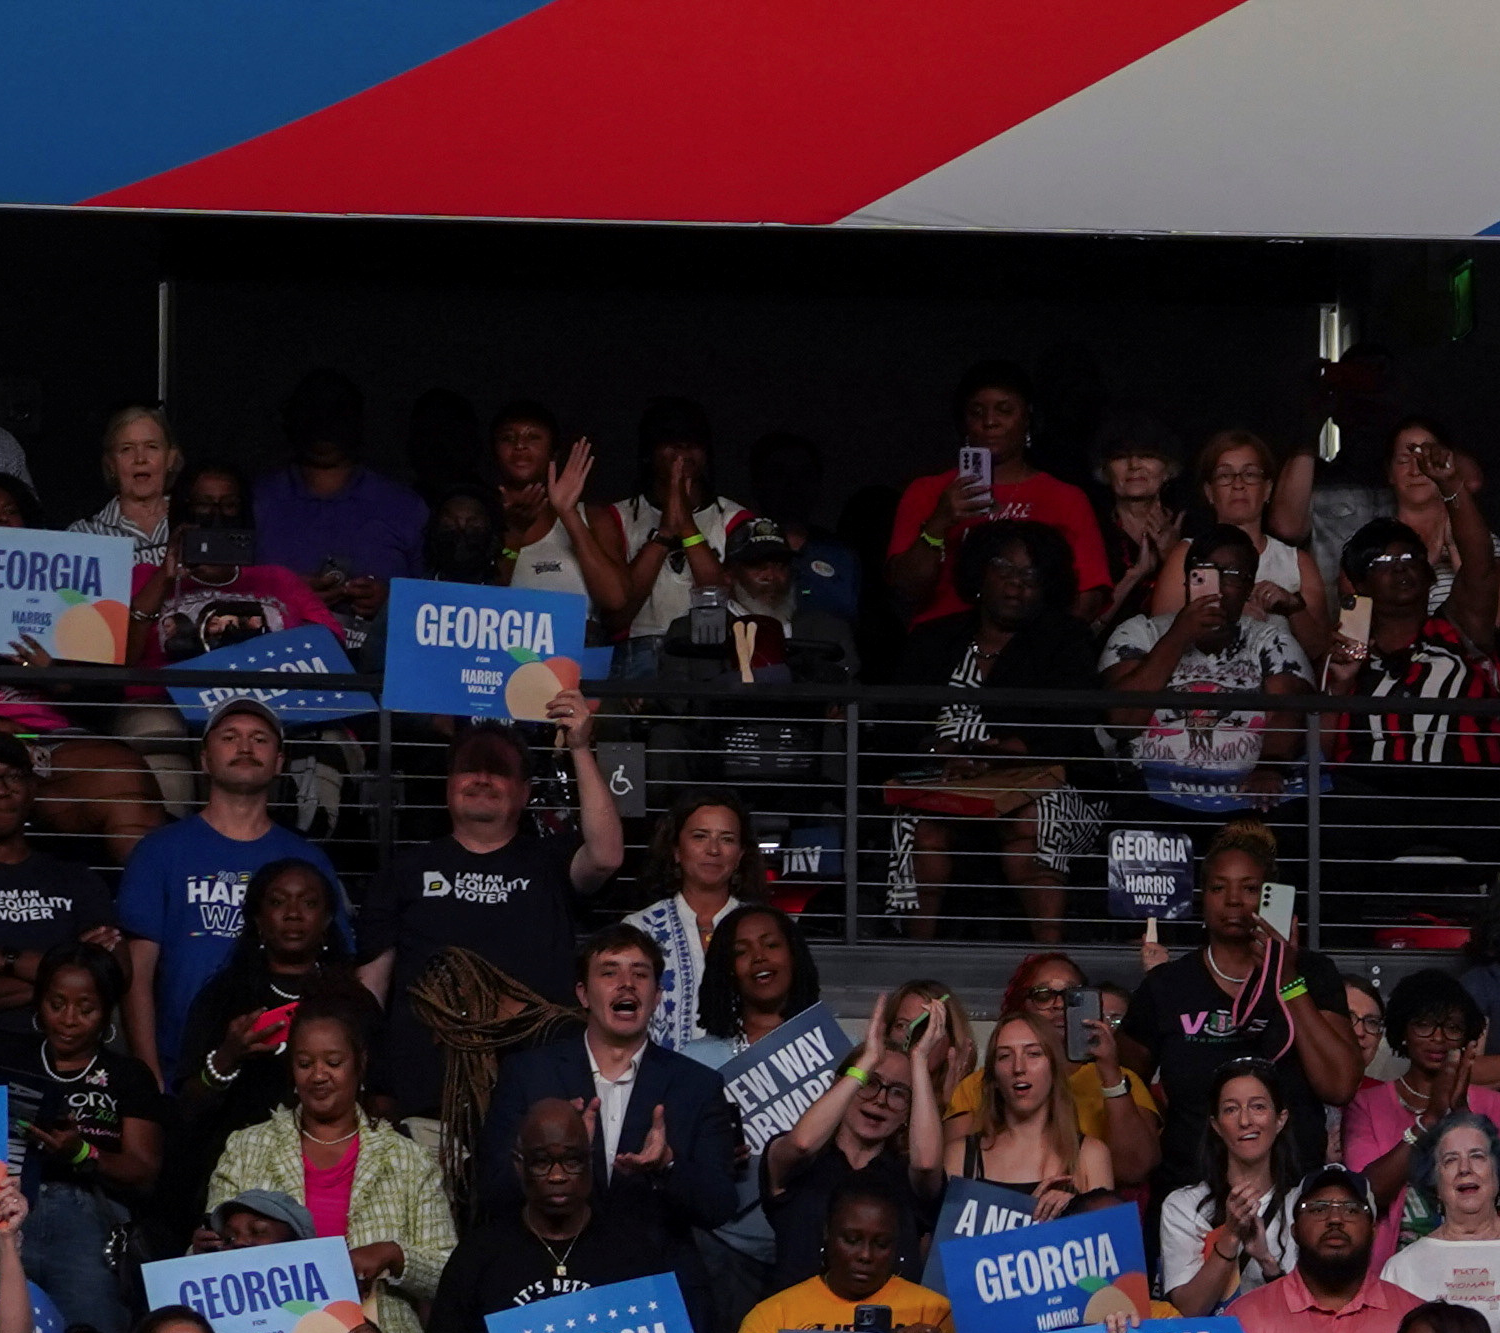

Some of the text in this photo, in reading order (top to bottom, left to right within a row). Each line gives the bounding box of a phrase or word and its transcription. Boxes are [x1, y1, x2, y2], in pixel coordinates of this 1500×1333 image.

[12, 610, 53, 627] HARRIS
[415, 603, 555, 654] GEORGIA
[460, 668, 503, 687] HARRIS
[468, 684, 496, 695] WALZ
[1112, 834, 1187, 862] GEORGIA
[454, 876, 530, 893] EQUALITY
[1124, 875, 1177, 894] HARRIS
[454, 889, 510, 903] VOTER
[1134, 894, 1168, 905] WALZ
[976, 1231, 1120, 1301] GEORGIA
[1444, 1280, 1495, 1289] WOMAN
[1038, 1305, 1080, 1328] HARRIS
